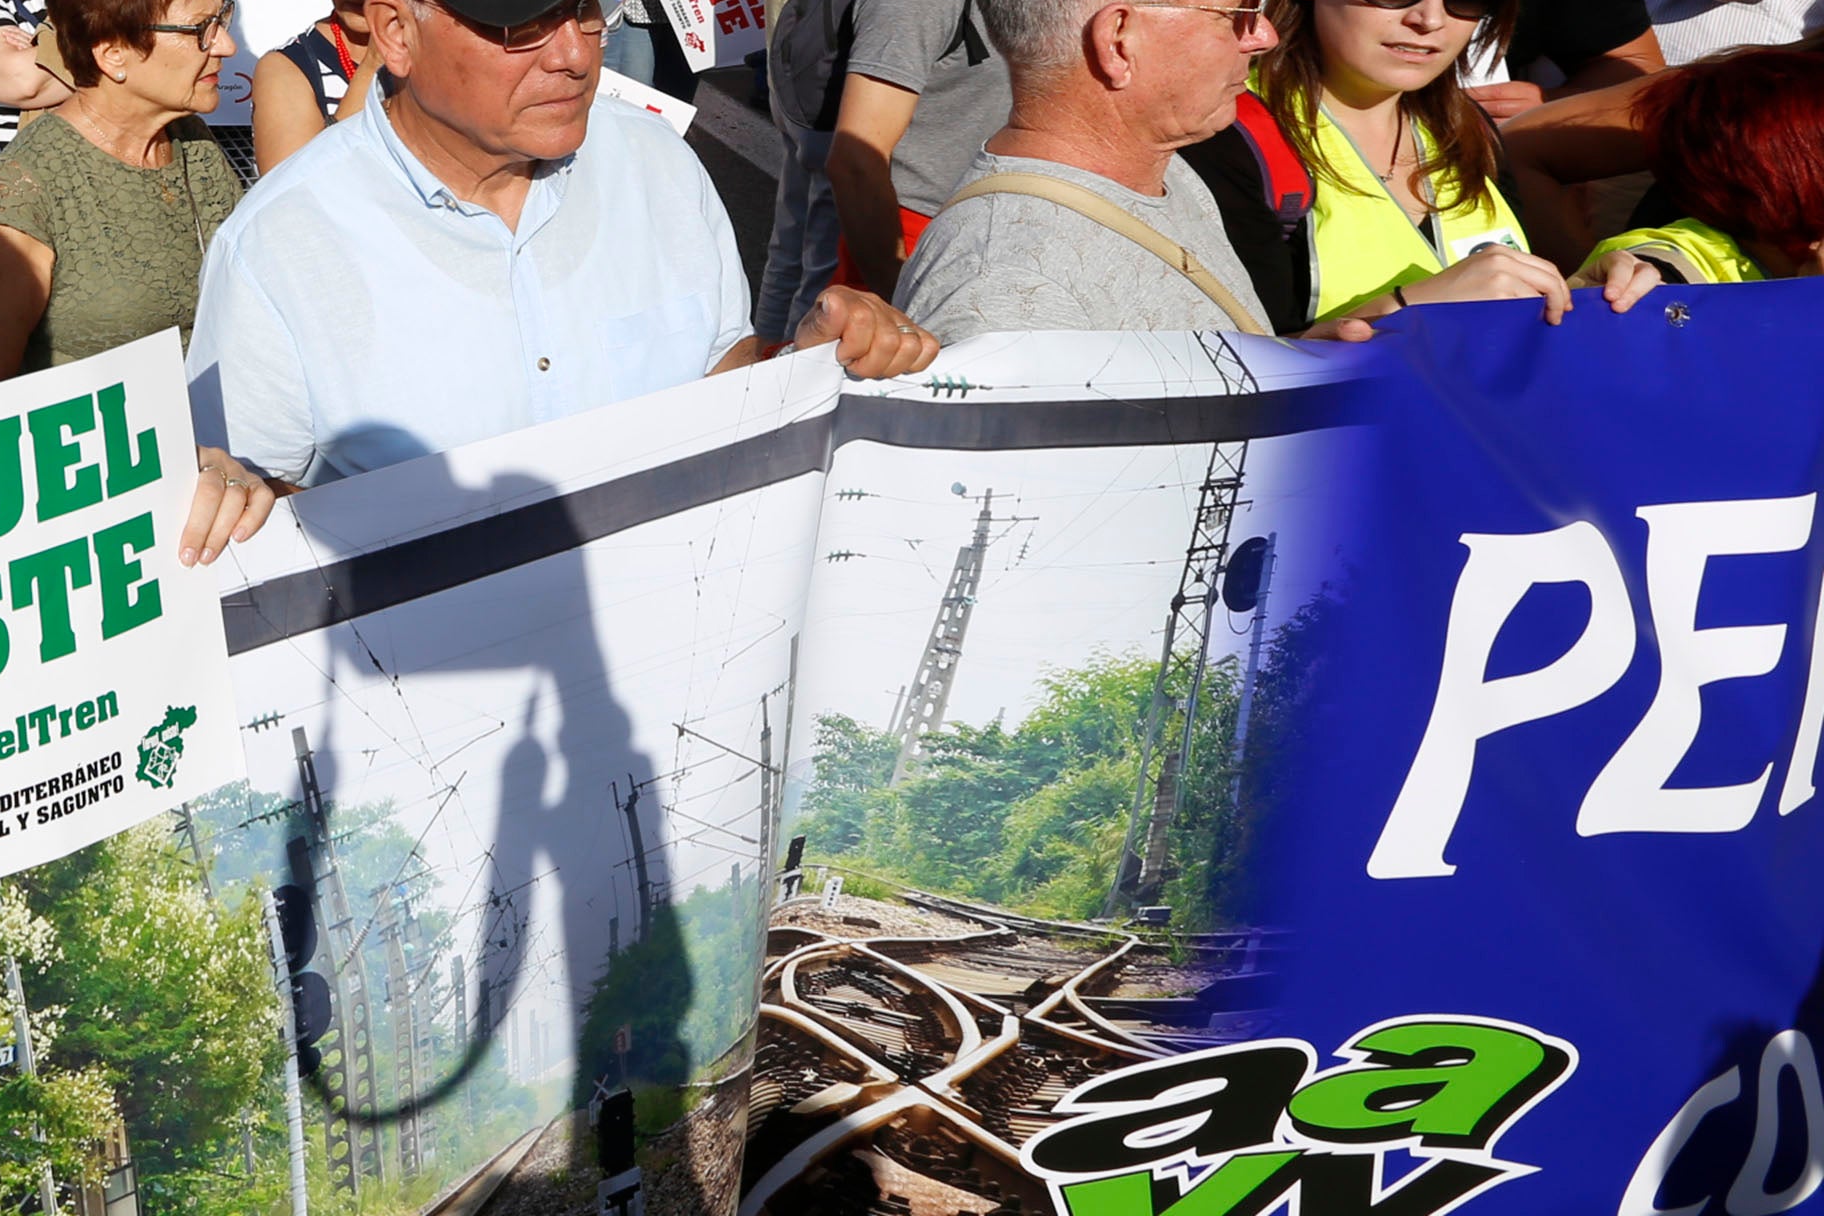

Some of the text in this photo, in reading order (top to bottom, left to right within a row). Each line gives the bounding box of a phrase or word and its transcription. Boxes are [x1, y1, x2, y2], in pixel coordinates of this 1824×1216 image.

[1366, 491, 1824, 881] PE
[14, 816, 32, 837] Y
[34, 775, 125, 828] SAGUNTO
